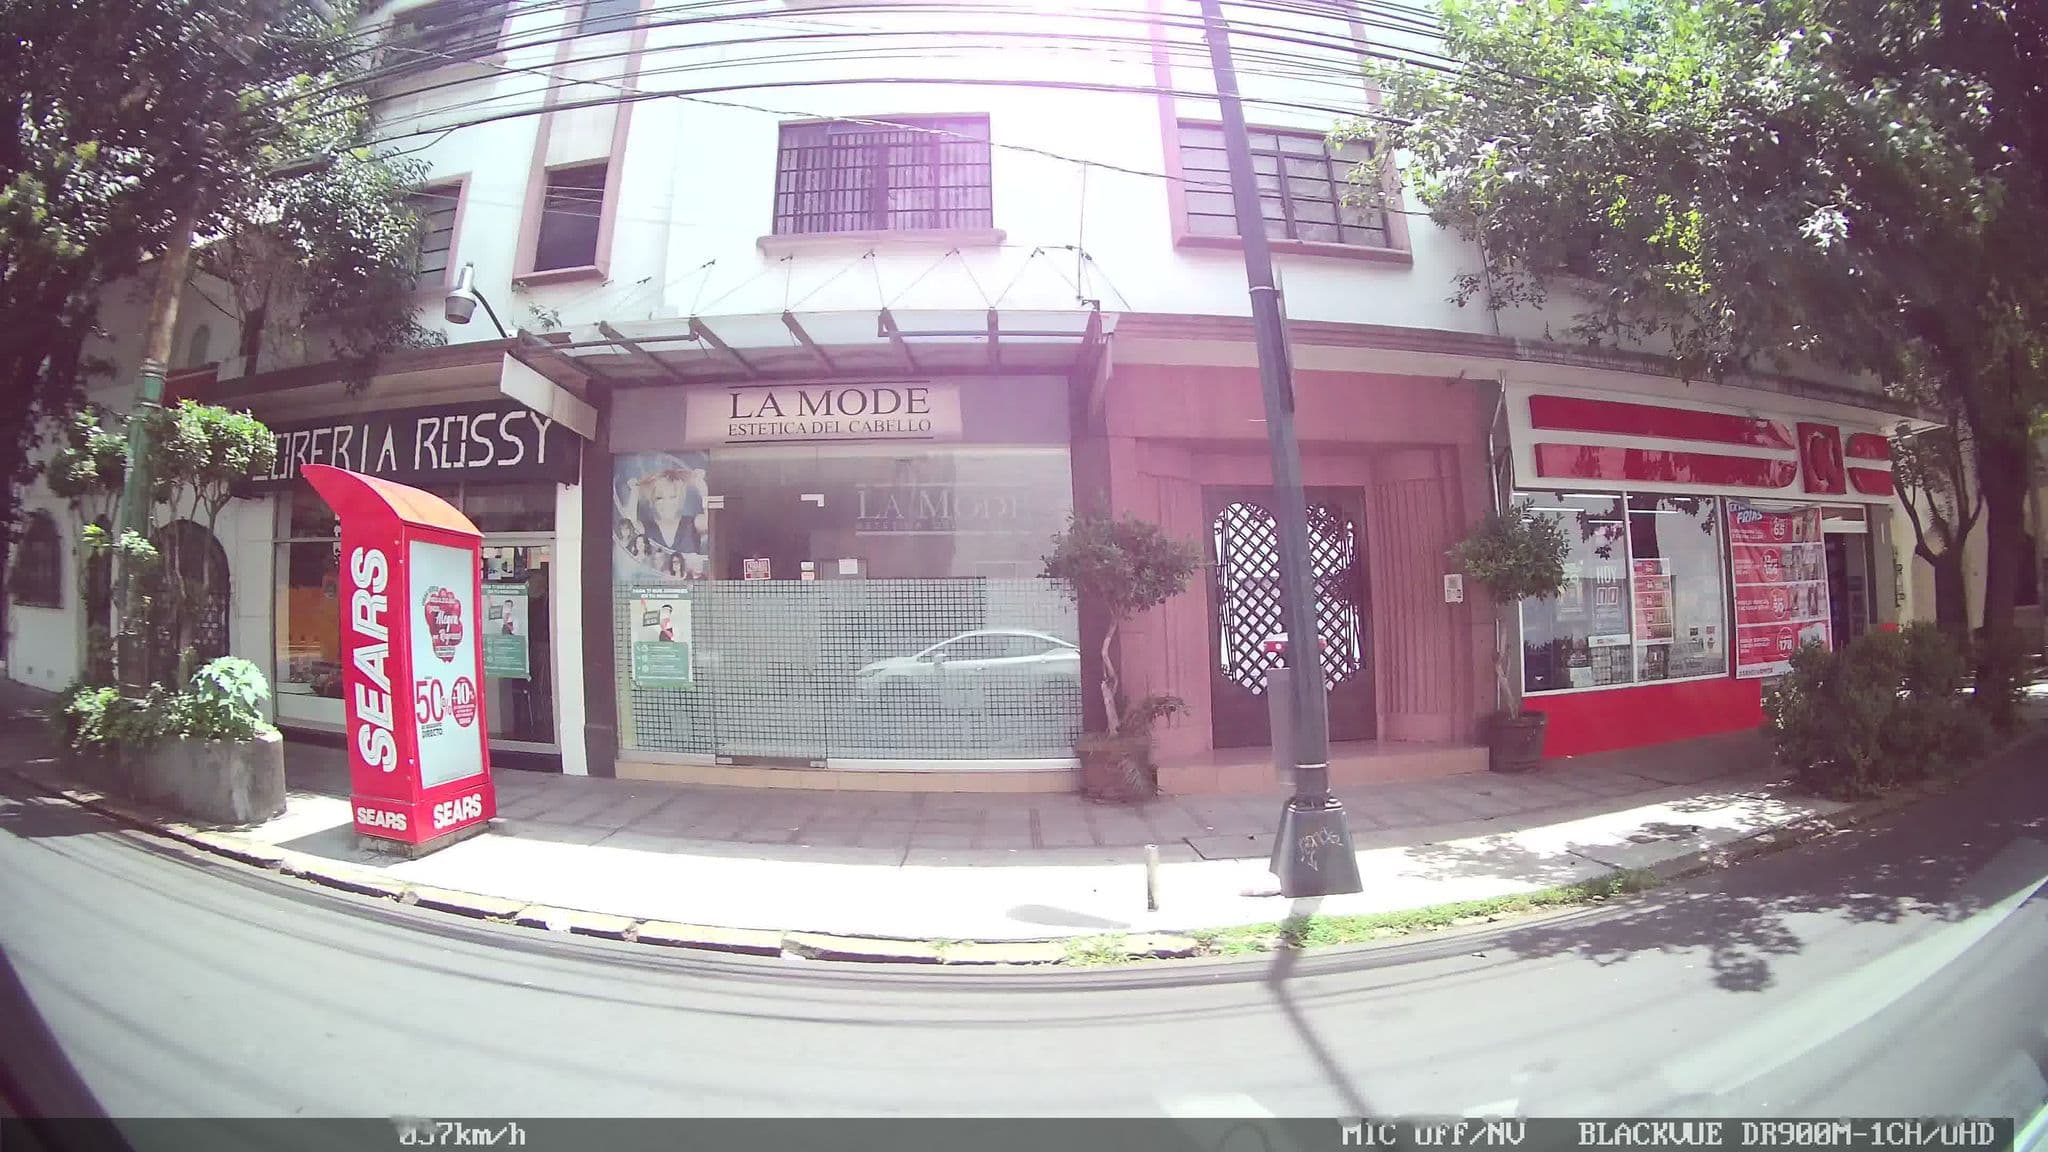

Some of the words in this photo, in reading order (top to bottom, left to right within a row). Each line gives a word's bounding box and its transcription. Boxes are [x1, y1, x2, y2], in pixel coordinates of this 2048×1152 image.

[729, 391, 786, 419] LA
[798, 387, 930, 417] MODE
[414, 411, 552, 470] ROSSY
[728, 421, 806, 437] ESTETICA
[812, 420, 841, 434] DEL
[849, 417, 931, 433] CABELLO
[857, 490, 905, 520] LA
[350, 546, 398, 773] SEARS
[357, 806, 407, 831] SEARS
[433, 793, 482, 830] SEARS
